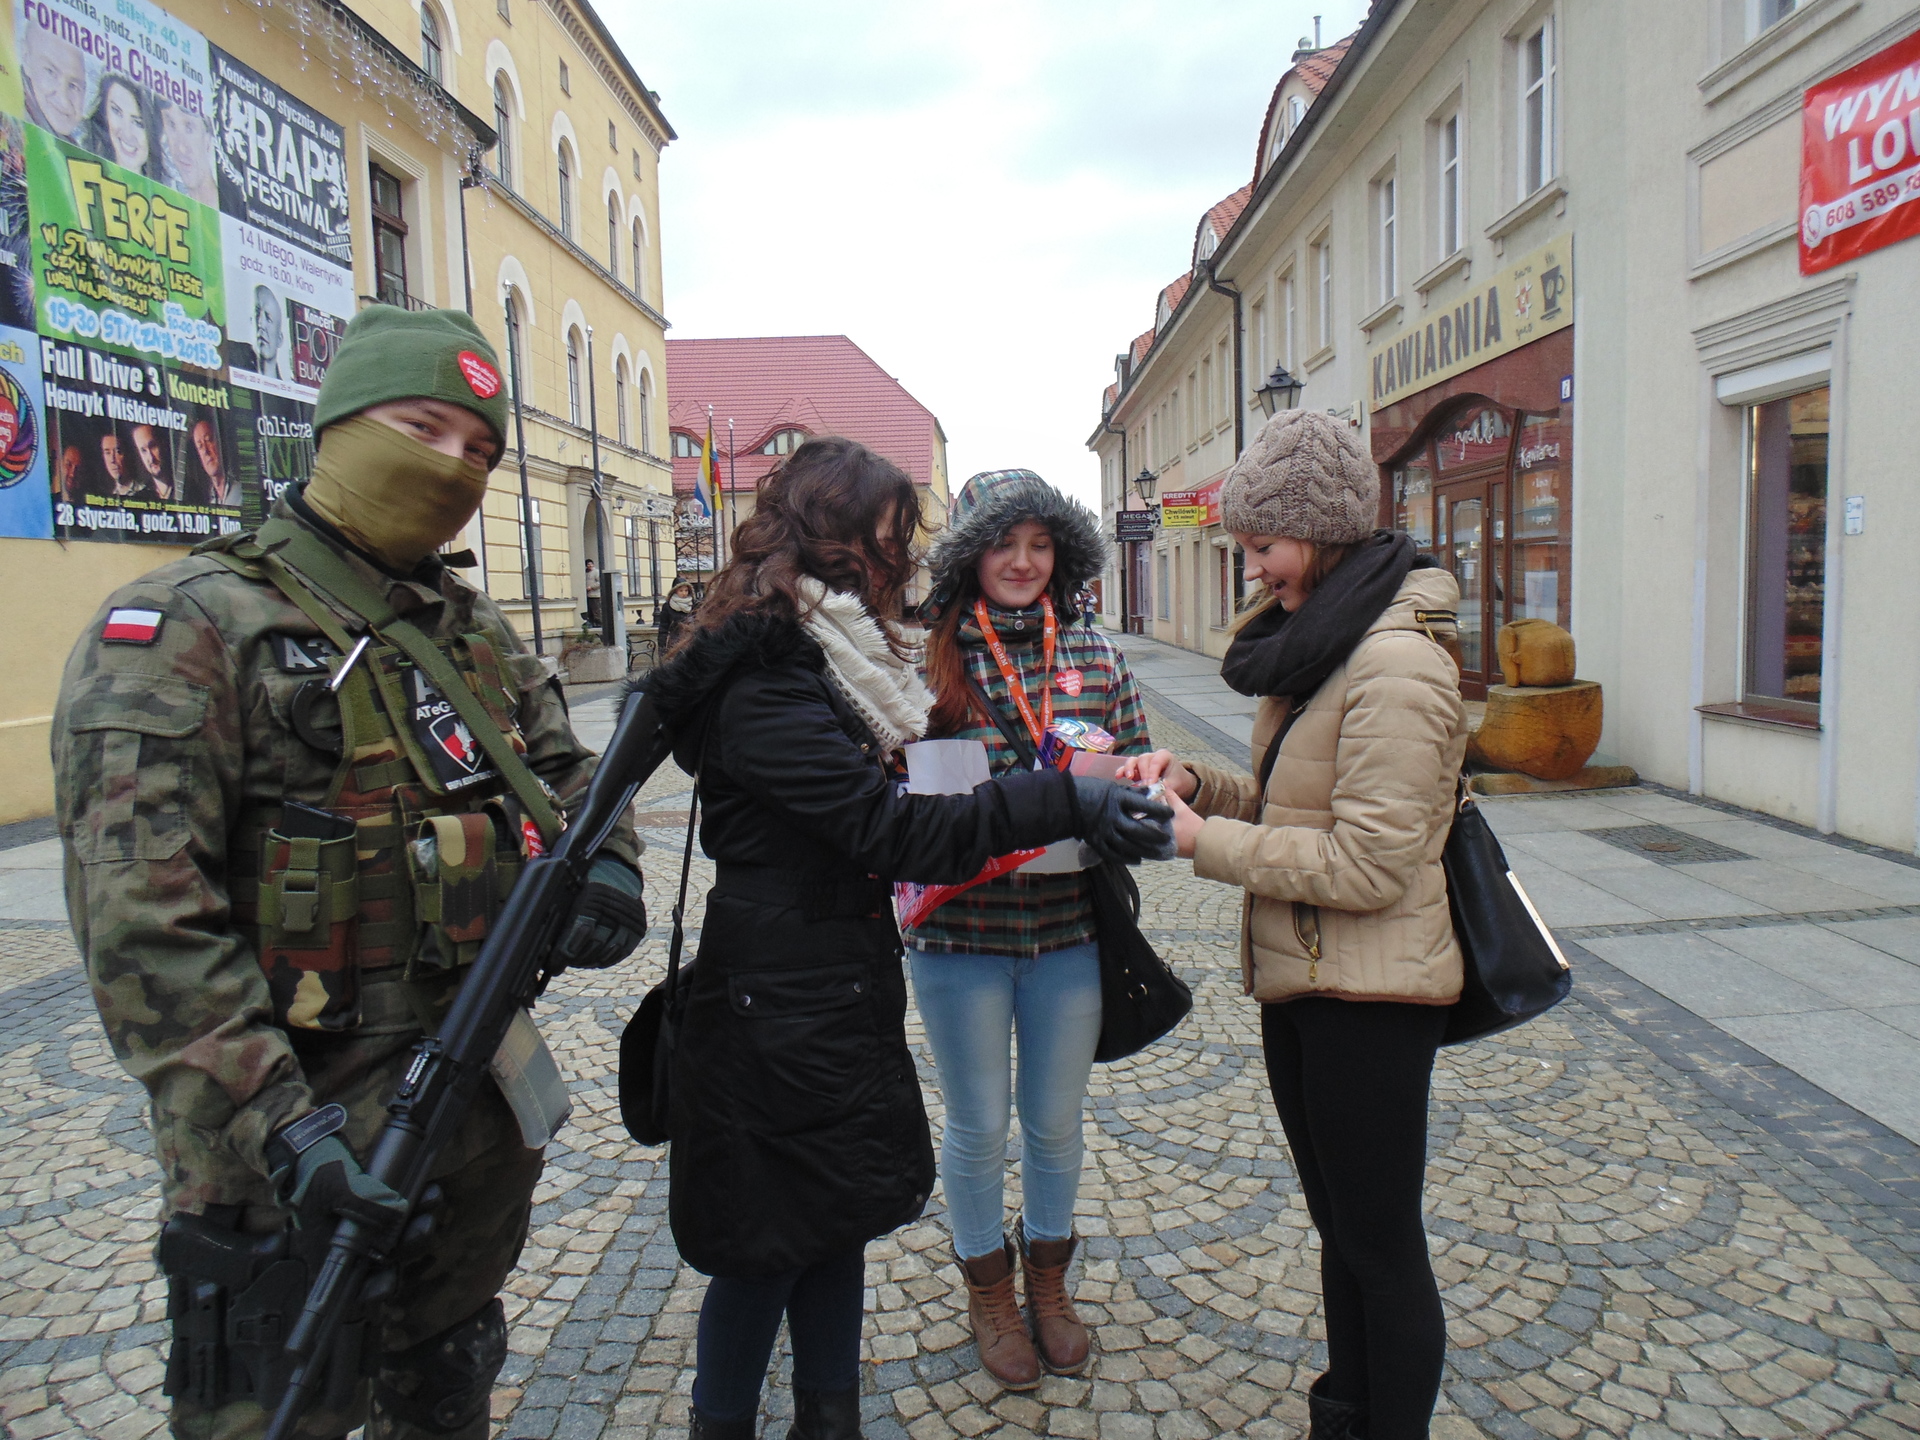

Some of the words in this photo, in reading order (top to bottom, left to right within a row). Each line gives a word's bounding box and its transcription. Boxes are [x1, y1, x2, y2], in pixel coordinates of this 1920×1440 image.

[24, 0, 122, 74] Formacja
[129, 48, 205, 117] Chatelet
[103, 15, 134, 44] godz.
[139, 33, 169, 64] 18.00
[181, 58, 204, 85] Kino
[160, 26, 178, 47] 40
[219, 58, 260, 99] Koncert
[262, 86, 276, 110] 30
[277, 99, 319, 138] stycznia,
[320, 123, 341, 149] Aula
[247, 101, 326, 198] RAP
[246, 166, 336, 236] FESTIWAL
[1826, 202, 1856, 227] 608
[1861, 182, 1900, 212] 589
[41, 223, 59, 247] W
[239, 226, 254, 249] 14
[258, 232, 298, 270] lutego,
[300, 256, 343, 287] Walentynki
[296, 275, 315, 295] Kino
[50, 301, 98, 334] 19-30
[304, 308, 335, 332] Koncert
[1373, 286, 1501, 401] KAWIARNIA
[41, 339, 85, 381] Full
[90, 351, 144, 394] Drive
[148, 366, 162, 397] 3
[168, 373, 230, 411] Koncert
[44, 381, 104, 418] Henryk
[106, 394, 188, 432] Miśkiewicz
[257, 416, 313, 438] Oblicza
[57, 503, 75, 527] 28
[77, 506, 139, 533] stycznia,
